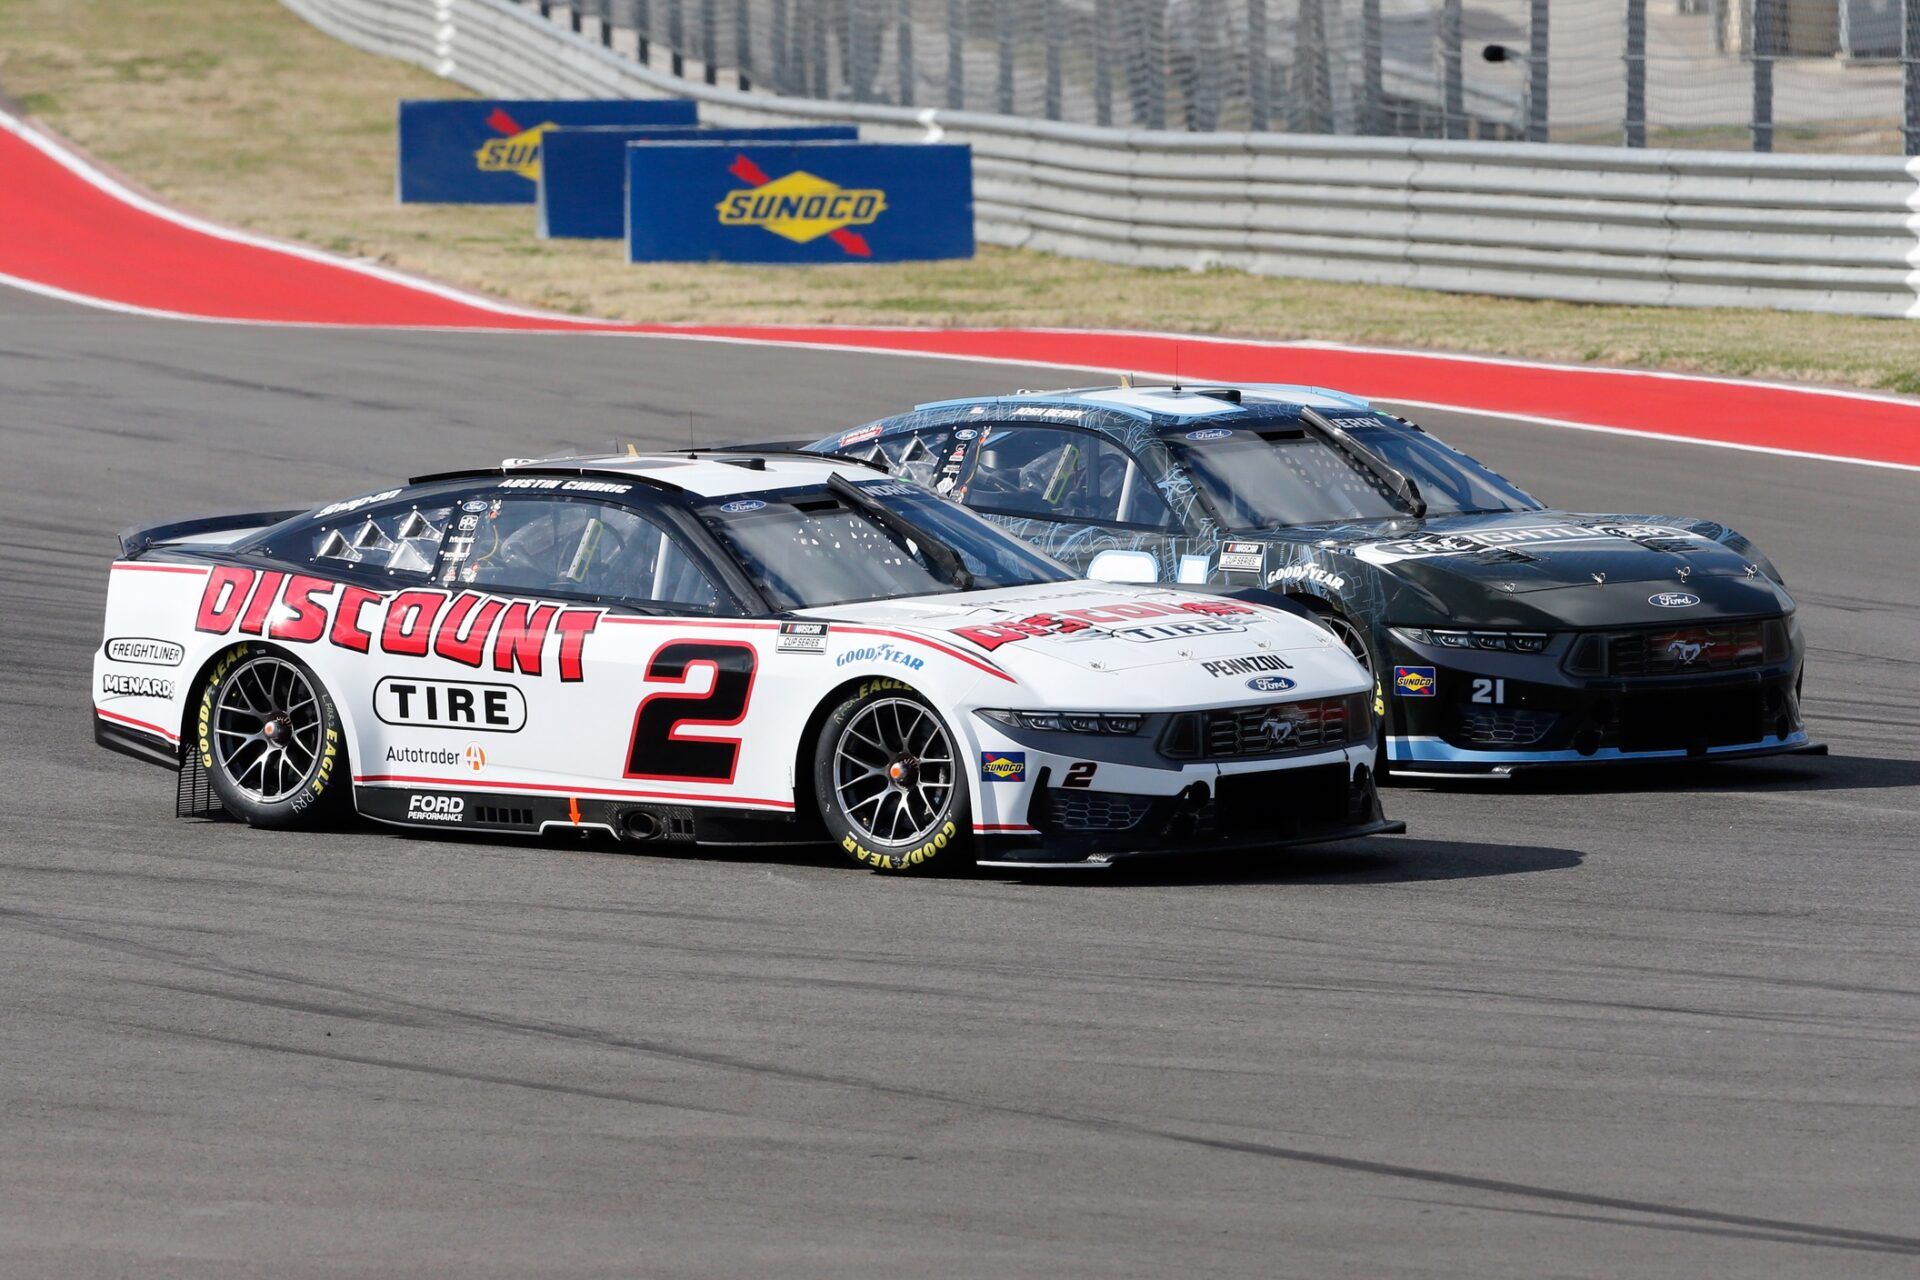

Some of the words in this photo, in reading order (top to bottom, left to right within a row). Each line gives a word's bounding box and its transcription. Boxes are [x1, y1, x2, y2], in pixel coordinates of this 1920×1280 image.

[725, 195, 877, 219] SUNOCO
[1012, 407, 1048, 416] JOSH
[1043, 408, 1085, 418] BERRY
[1193, 428, 1227, 441] Ford
[498, 478, 563, 489] AUSTIN
[561, 480, 632, 494] CINDRIC
[858, 483, 920, 497] NDRIC
[727, 500, 762, 513] Ford
[1233, 543, 1259, 554] NASCAR
[1225, 555, 1239, 564] CUP
[1239, 556, 1257, 566] SERIES
[1656, 593, 1694, 606] Ford
[194, 564, 606, 683] DISCOUNT
[794, 623, 823, 635] NASCAR
[1124, 619, 1236, 640] TIRE
[783, 637, 798, 646] CUP
[797, 638, 820, 648] SERIES
[112, 643, 181, 662] FREIGHTLINER
[1200, 654, 1295, 678] PENNZOIL
[102, 673, 176, 700] MENARDS
[859, 677, 914, 700] EAGLE
[1253, 676, 1291, 691] Ford
[1397, 677, 1433, 686] SUNOCO
[1471, 678, 1505, 704] 21
[388, 683, 511, 726] TIRE
[622, 637, 759, 785] 2
[311, 727, 339, 797] EAGLE
[385, 745, 461, 766] Autotrader
[983, 763, 1023, 772] SUNOCO
[1061, 761, 1099, 788] 2
[408, 794, 465, 813] FORD
[407, 811, 464, 822] PERFORMANCE
